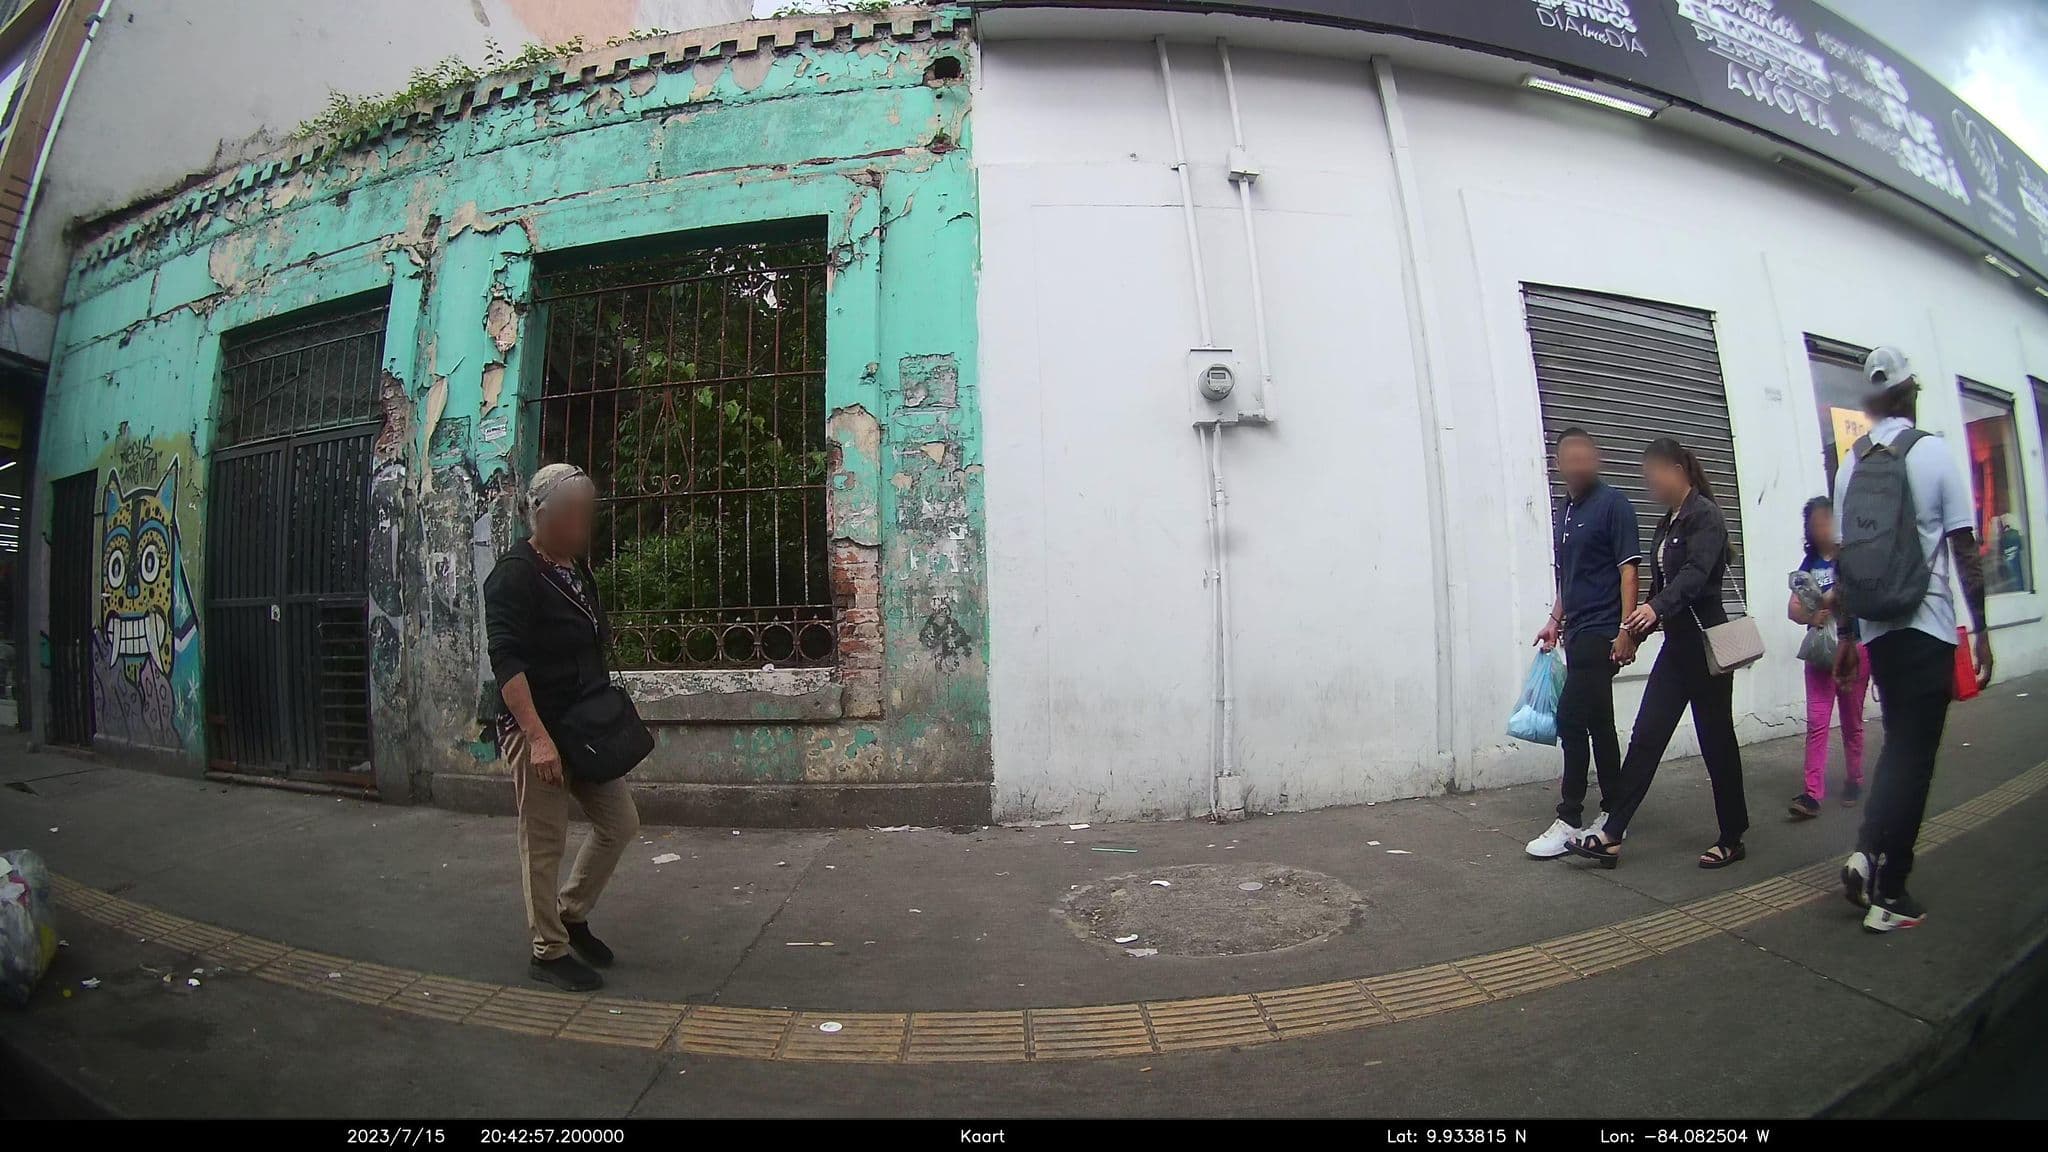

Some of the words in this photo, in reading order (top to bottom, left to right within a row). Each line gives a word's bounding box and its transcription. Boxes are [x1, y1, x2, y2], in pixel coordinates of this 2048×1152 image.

[1536, 7, 1582, 36] DÍA
[1605, 28, 1648, 58] DÍA
[1690, 22, 1832, 98] PERFECTO
[1727, 61, 1840, 136] AHORA
